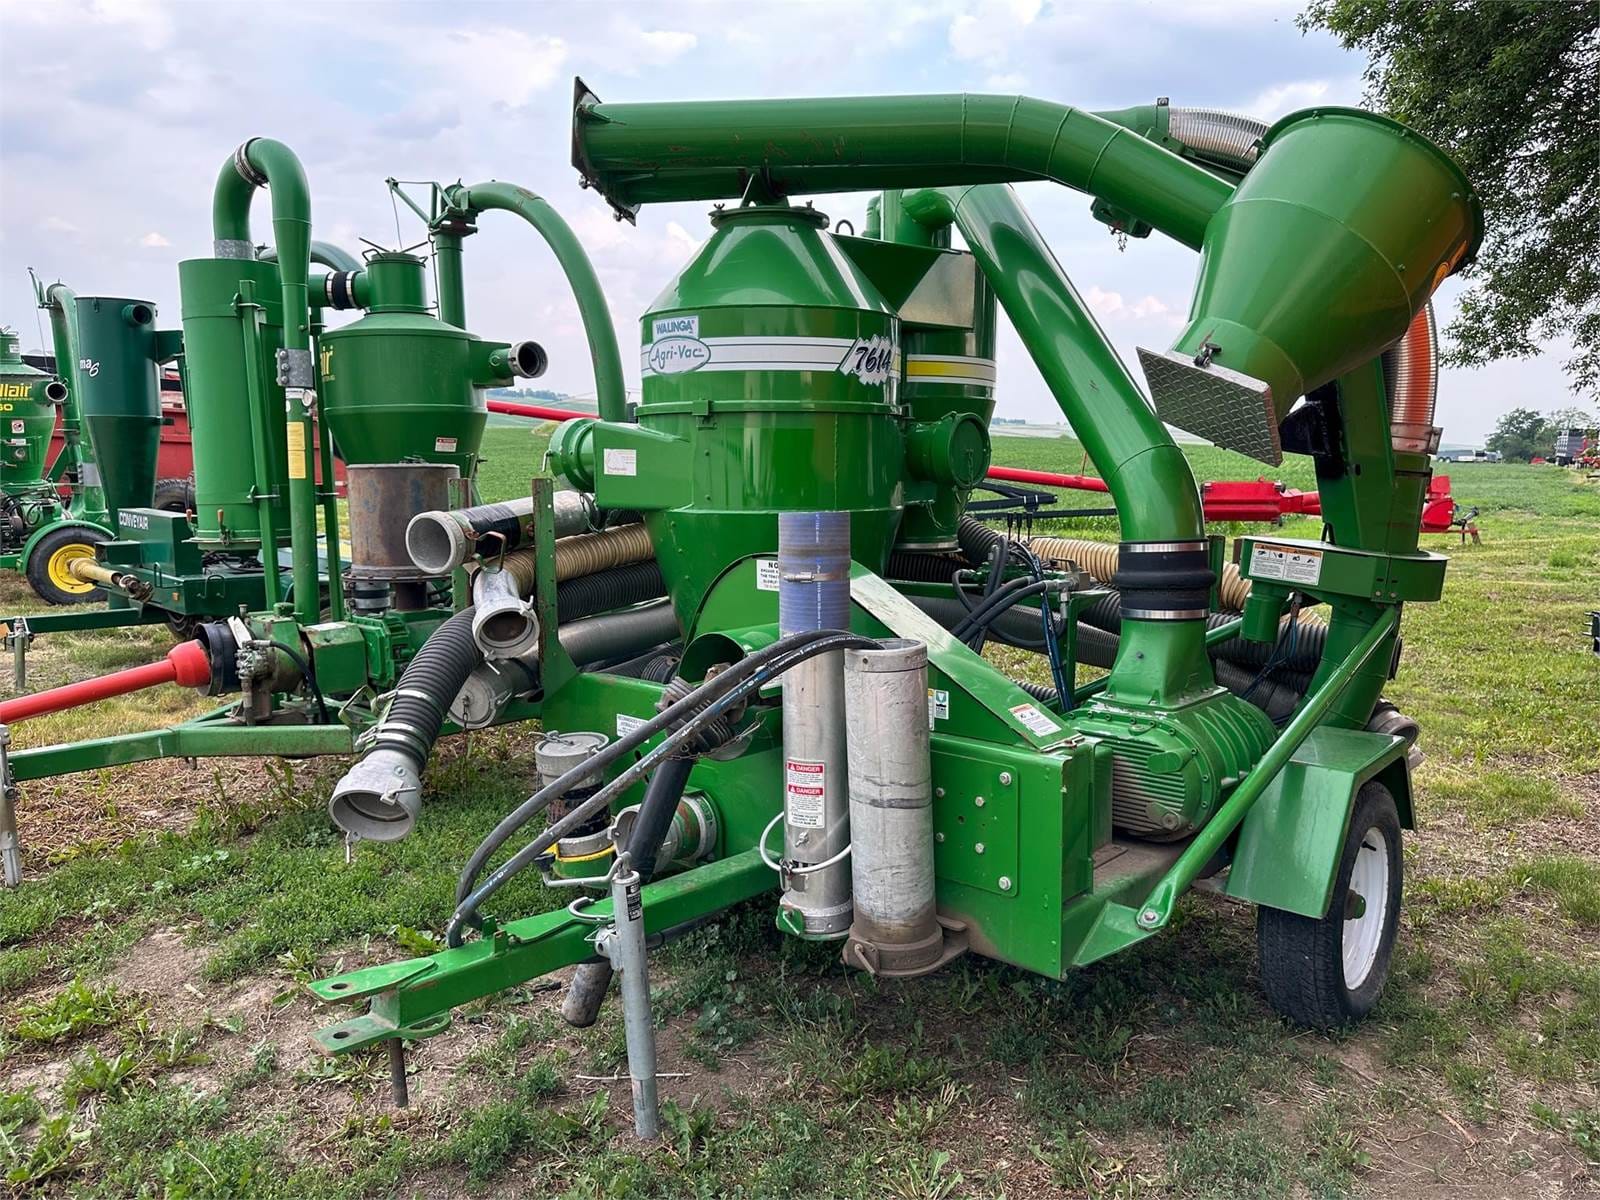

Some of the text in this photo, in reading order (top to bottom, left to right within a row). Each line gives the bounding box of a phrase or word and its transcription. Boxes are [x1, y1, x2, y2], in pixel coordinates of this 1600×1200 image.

[656, 320, 693, 335] WALINGA
[651, 345, 705, 369] Agri-Vac
[855, 346, 892, 373] 7614
